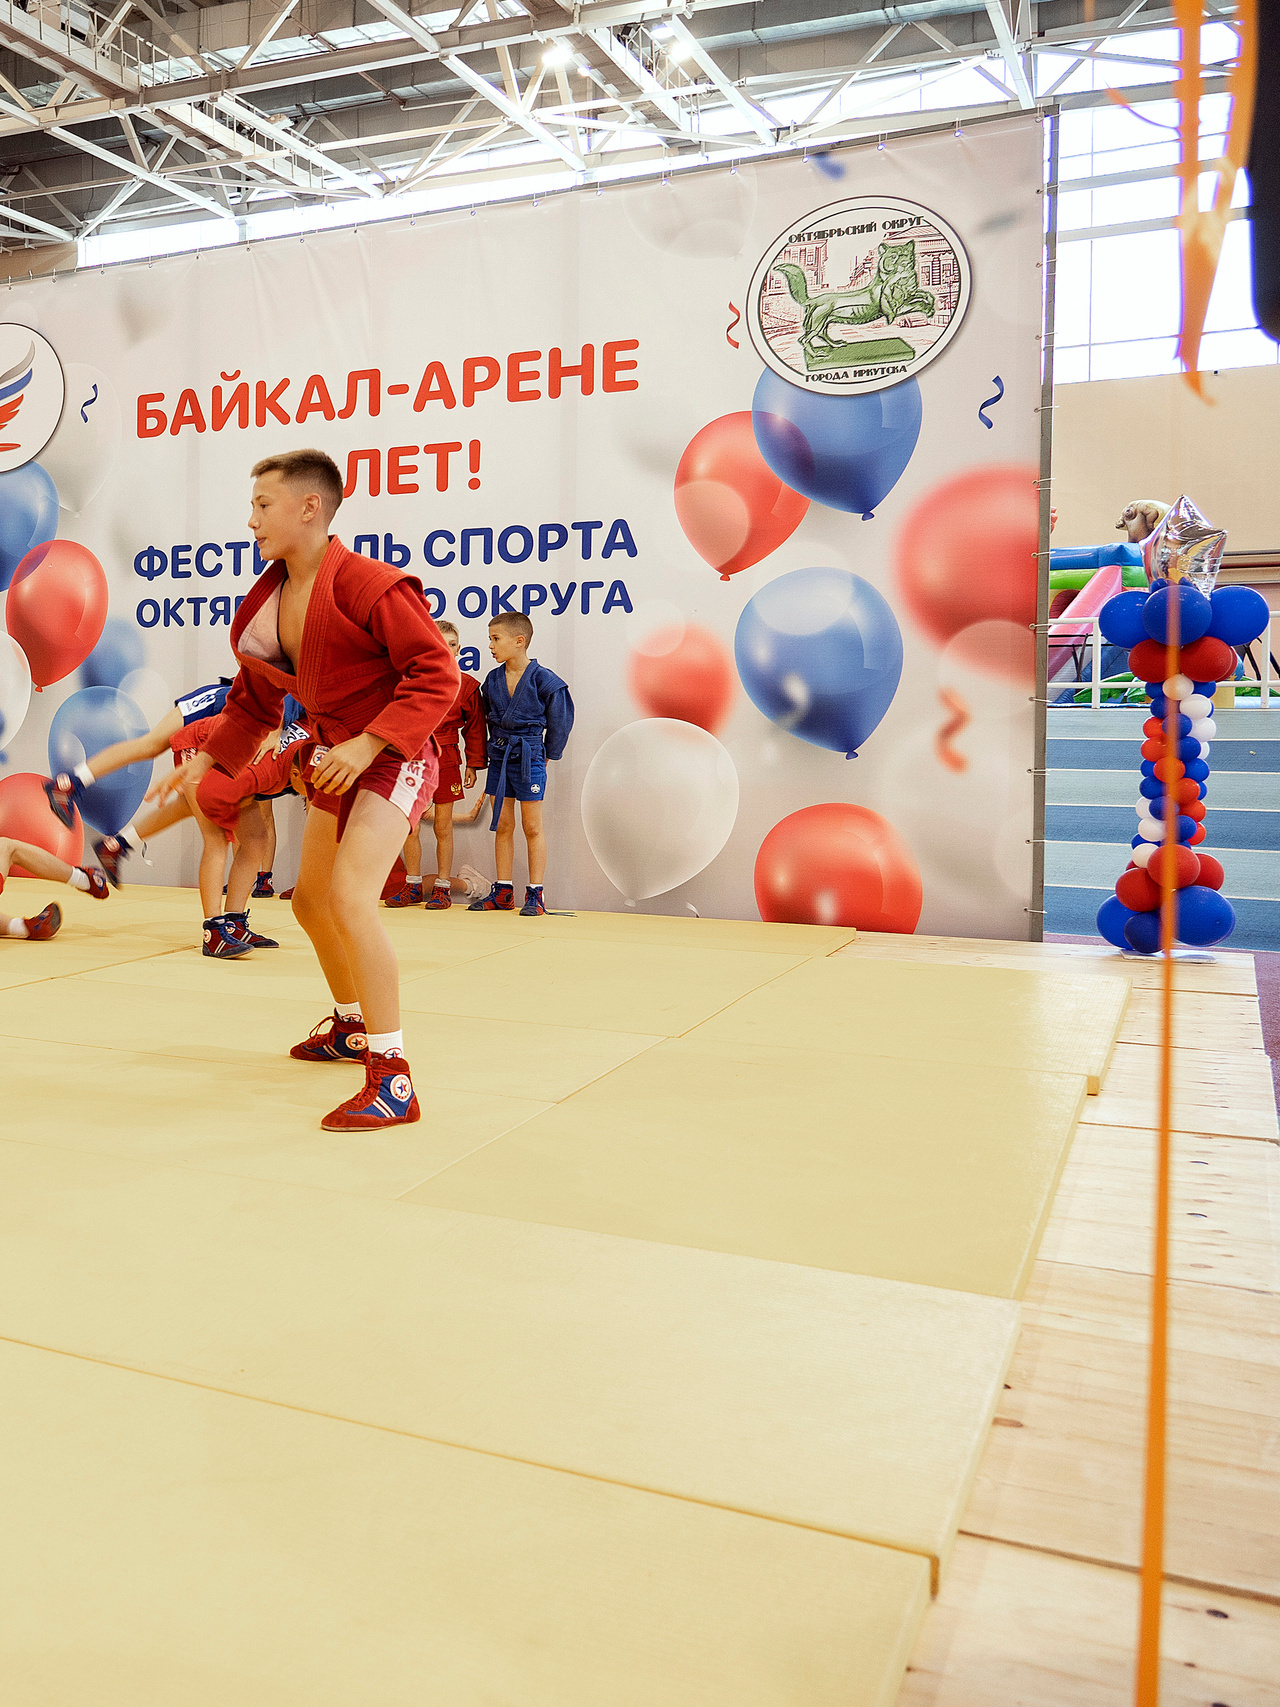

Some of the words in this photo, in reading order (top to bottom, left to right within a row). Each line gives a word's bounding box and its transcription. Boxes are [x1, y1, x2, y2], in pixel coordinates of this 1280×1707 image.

[788, 222, 877, 244] ОКТЯБРЬСКИЙ
[882, 215, 924, 232] ОКРУГ
[136, 339, 639, 439] БАЙКАЛ-АРЕНЕ
[805, 369, 849, 382] ГОРОДА
[853, 365, 907, 377] ИРКУТСКА
[343, 439, 481, 499] ЛЕТ!
[423, 518, 638, 567] СПОРТА
[457, 579, 634, 619] ОКРУГА
